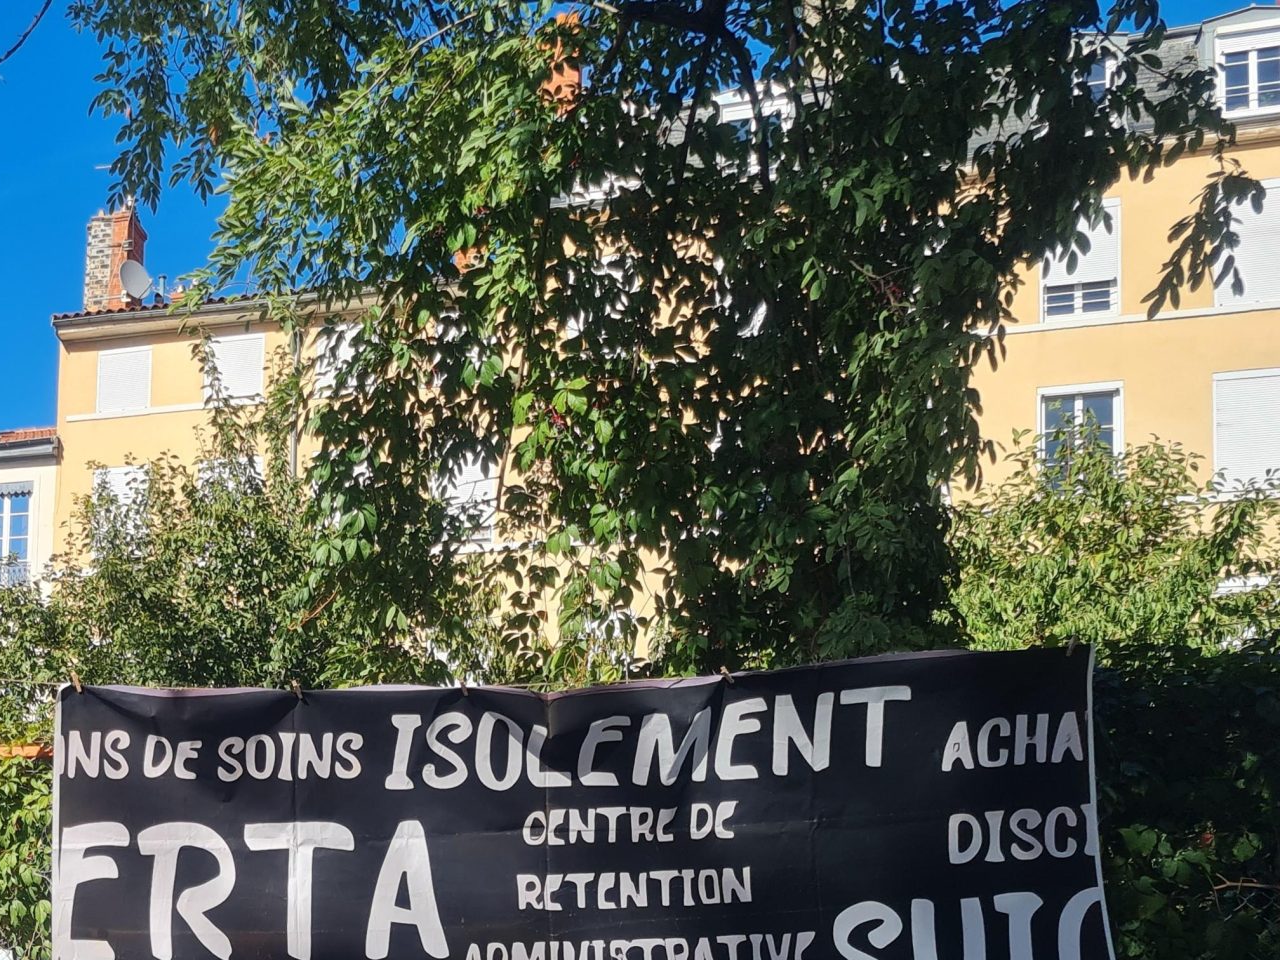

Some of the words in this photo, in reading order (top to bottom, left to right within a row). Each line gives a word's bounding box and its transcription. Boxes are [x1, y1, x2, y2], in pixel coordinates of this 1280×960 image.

[60, 729, 130, 780] NS
[143, 735, 203, 780] DE
[217, 731, 364, 782] SOINS
[385, 684, 912, 791] ISOLEMENT
[941, 710, 1089, 773] ACHA
[522, 806, 679, 846] CENTRE
[689, 800, 739, 840] DE
[516, 866, 752, 911] RETENTION
